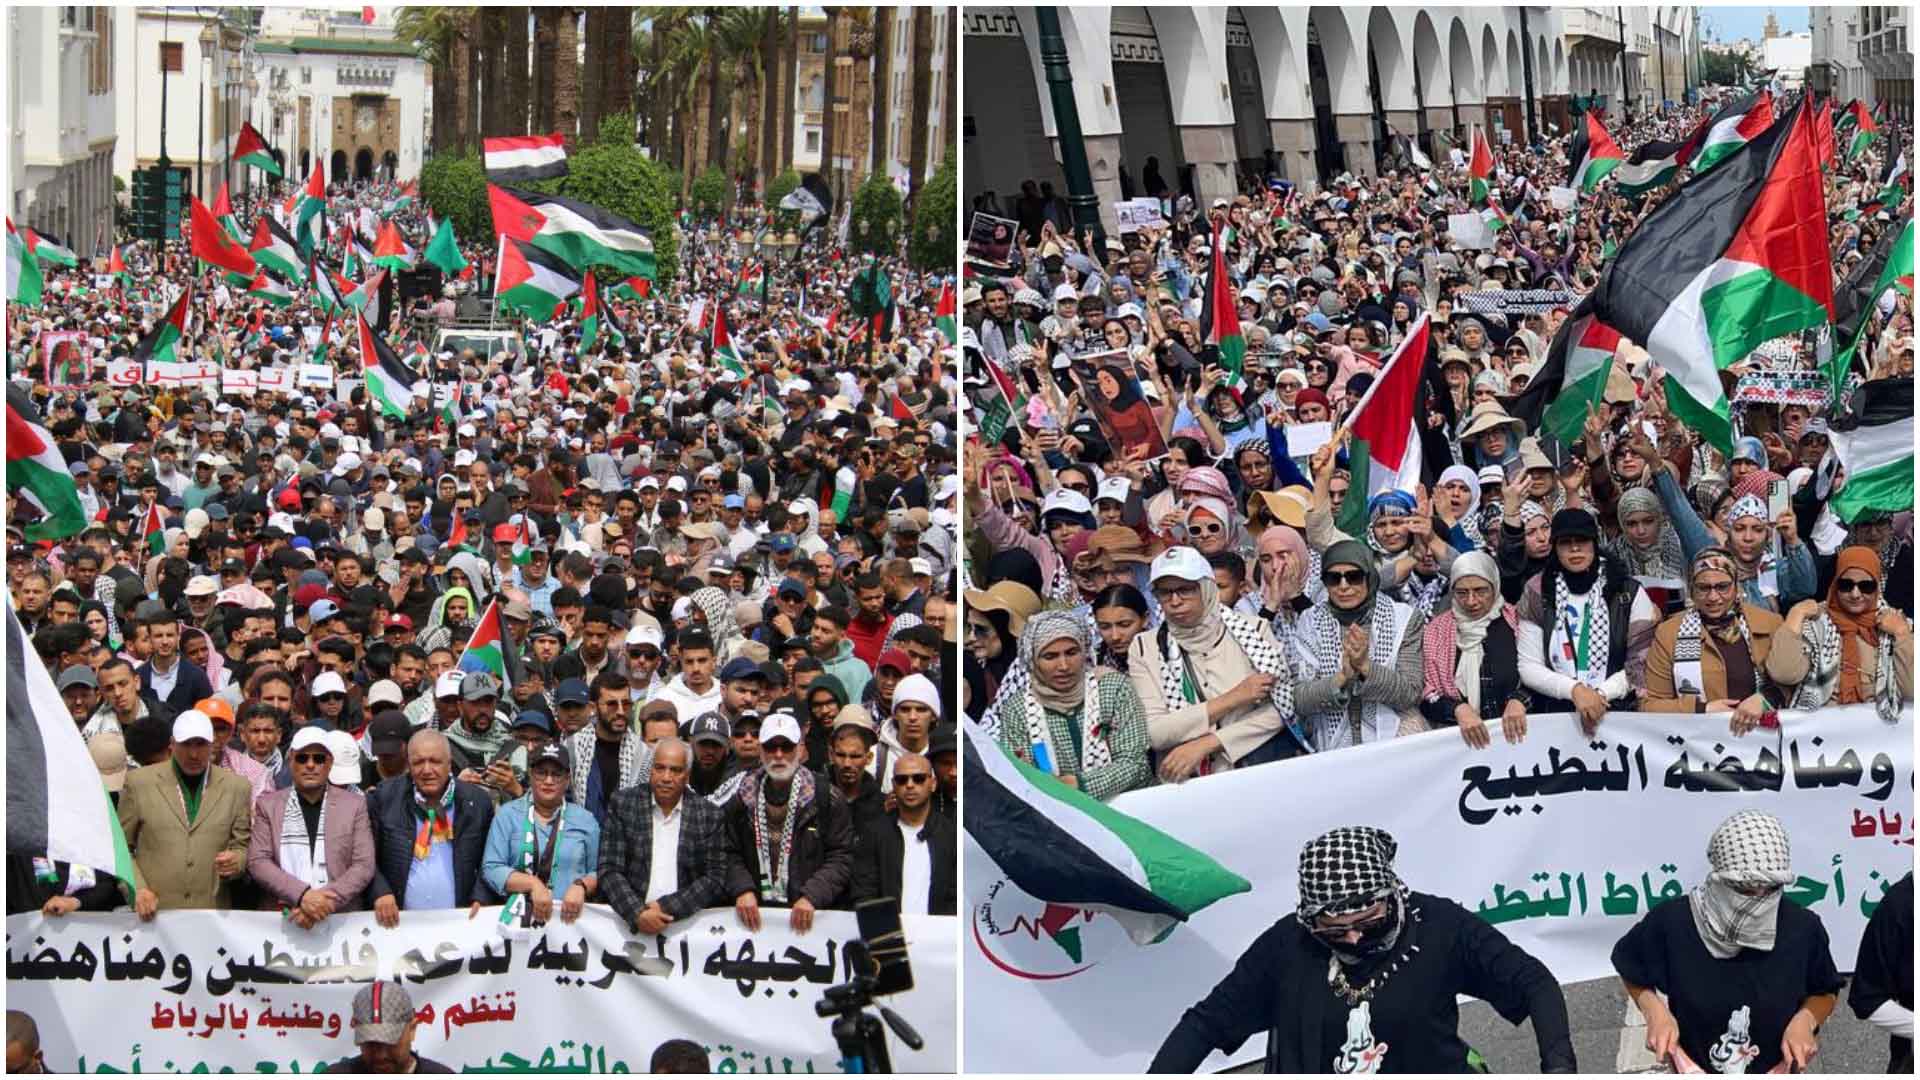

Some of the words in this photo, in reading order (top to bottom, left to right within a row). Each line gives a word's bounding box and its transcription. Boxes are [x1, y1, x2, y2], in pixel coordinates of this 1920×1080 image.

[1459, 741, 1648, 825] التطبيع
[1664, 736, 1895, 801] ومناهضة
[6, 934, 192, 995] ومناهض
[206, 928, 377, 996] فلسطين
[703, 926, 851, 998] الجبهة
[151, 1001, 248, 1038] بالرباط
[257, 997, 341, 1038] وطنية
[444, 992, 516, 1040] تنظم
